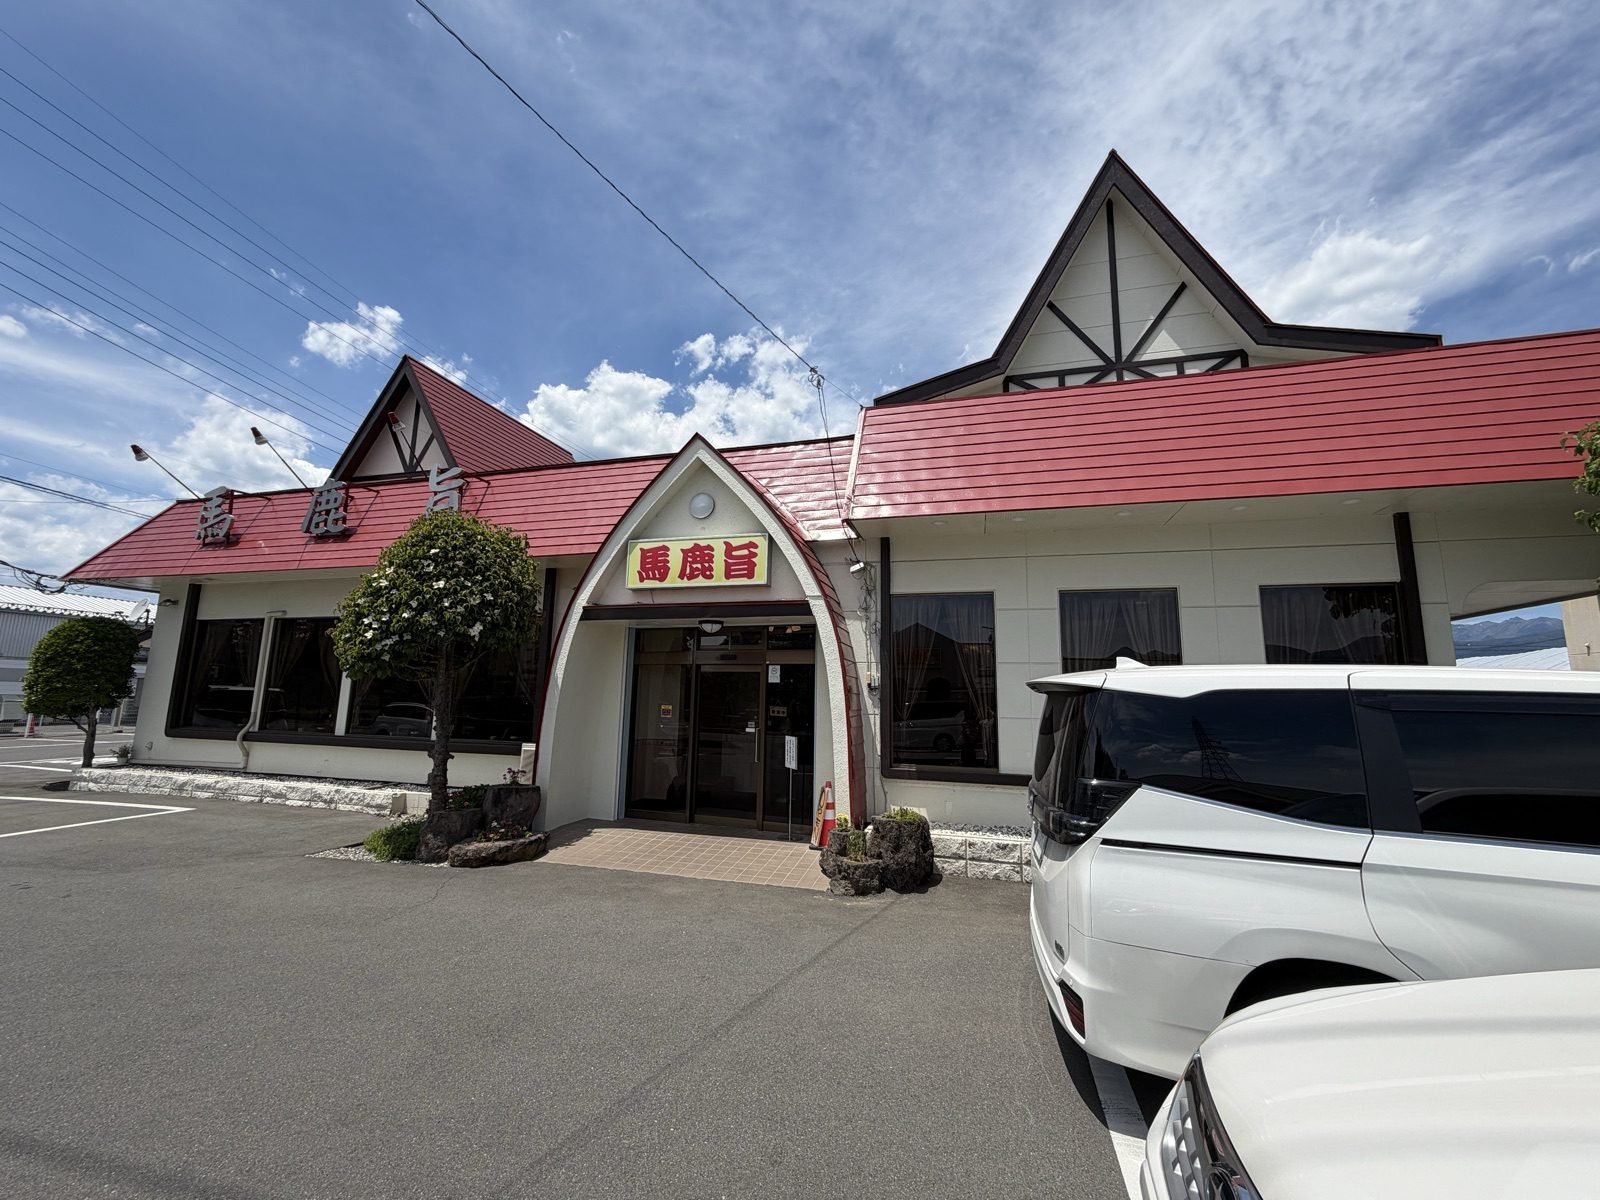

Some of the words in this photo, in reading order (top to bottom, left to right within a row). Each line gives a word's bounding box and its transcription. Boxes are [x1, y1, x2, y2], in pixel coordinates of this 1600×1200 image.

[194, 464, 466, 540] 馬鹿旨
[637, 541, 759, 582] 馬鹿旨
